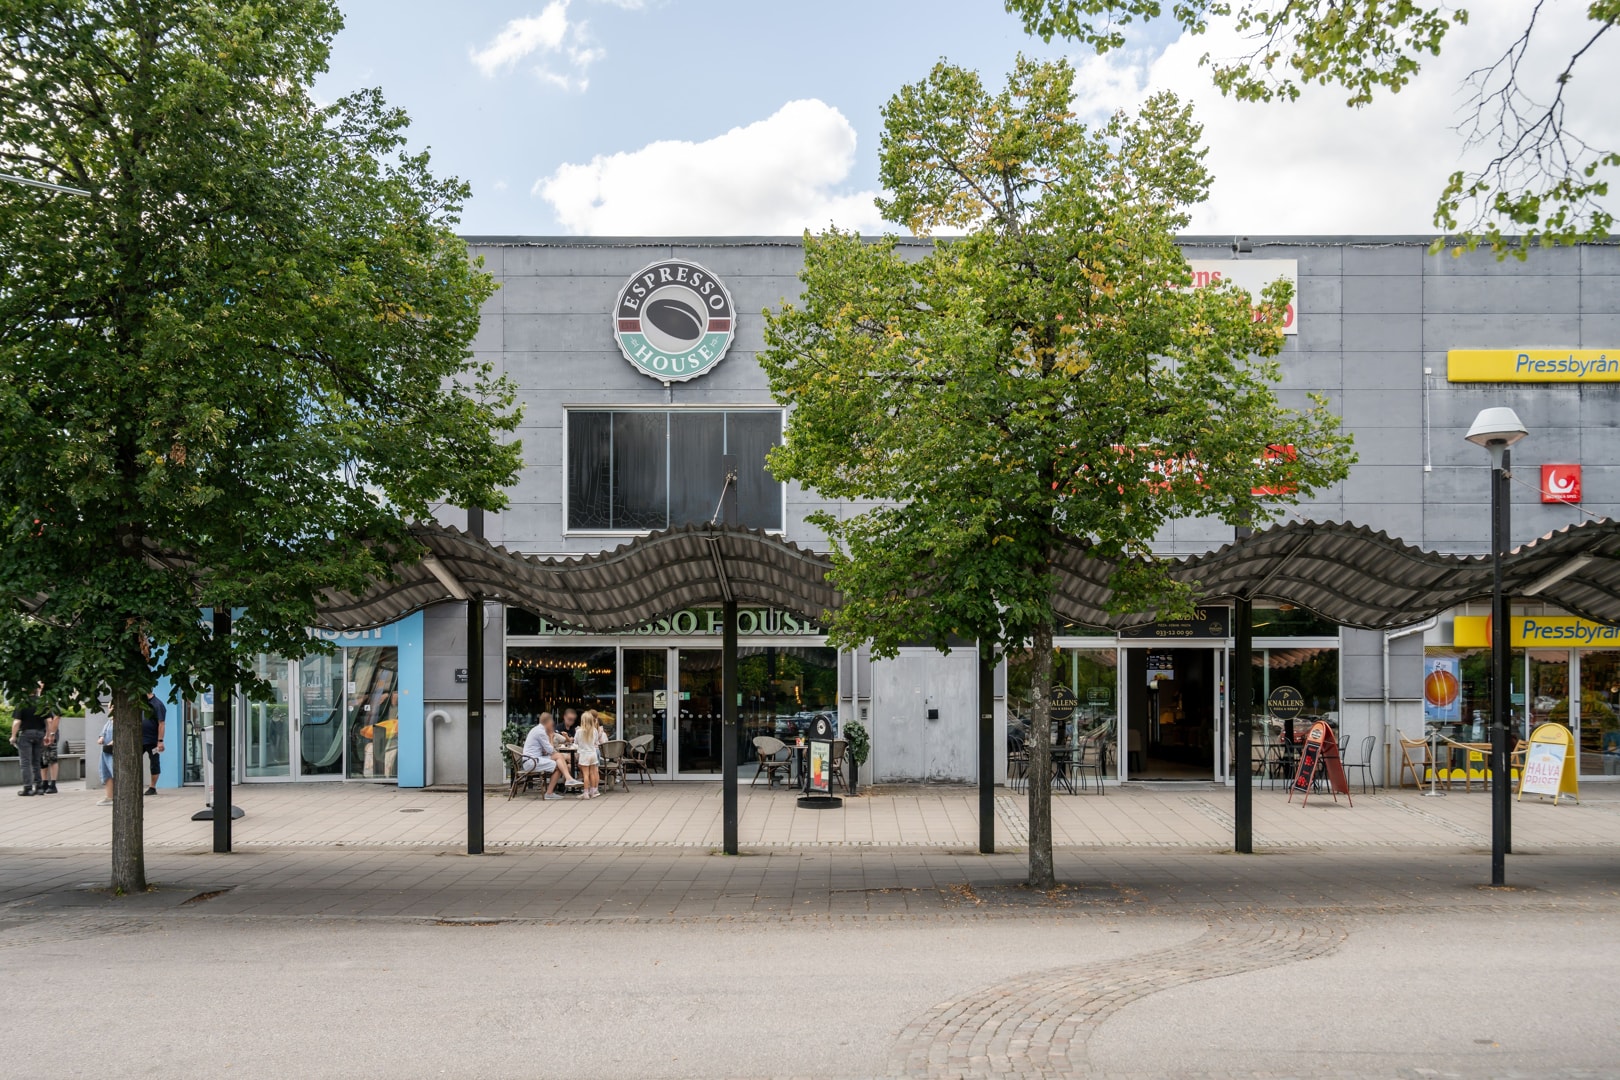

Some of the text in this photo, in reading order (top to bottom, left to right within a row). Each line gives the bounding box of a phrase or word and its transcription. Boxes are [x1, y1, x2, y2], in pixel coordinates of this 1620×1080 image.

[624, 267, 724, 310] ESPRESSO
[635, 345, 714, 373] HOUSE
[1516, 353, 1619, 377] Pressbyrån
[538, 611, 698, 635] ESSO
[1527, 762, 1560, 776] HALVA
